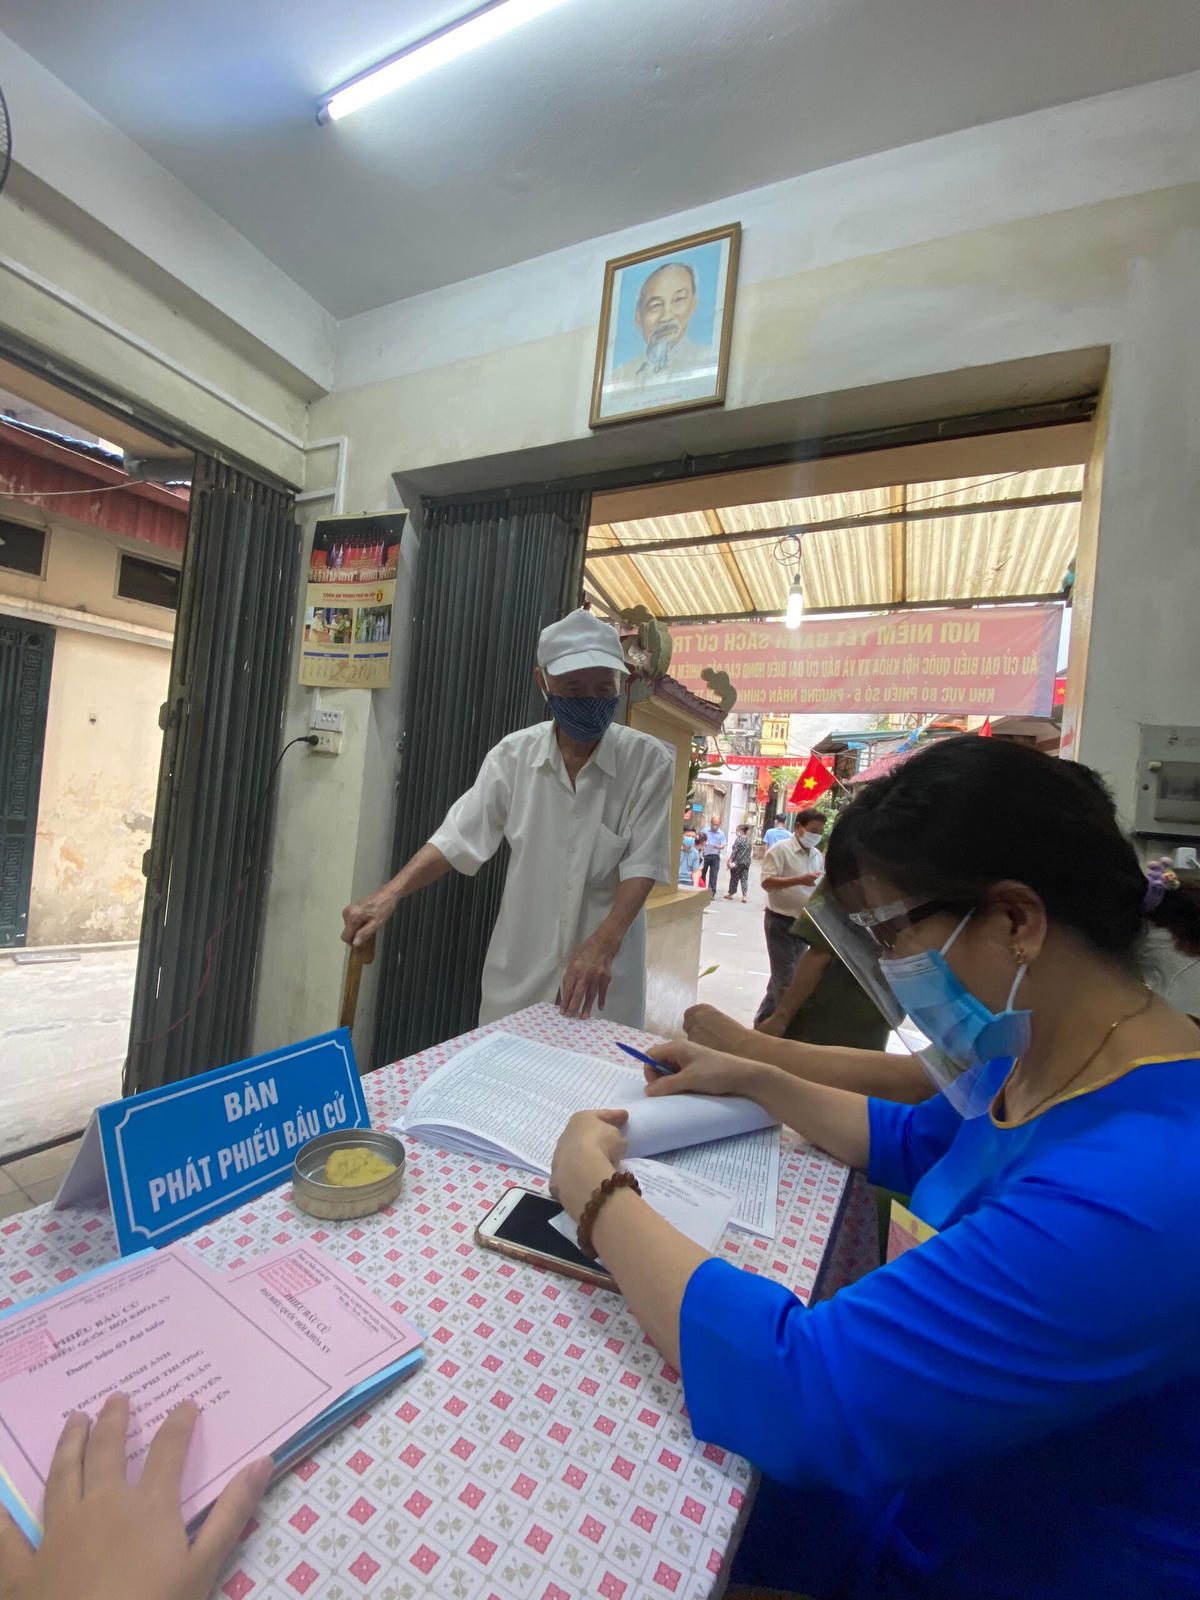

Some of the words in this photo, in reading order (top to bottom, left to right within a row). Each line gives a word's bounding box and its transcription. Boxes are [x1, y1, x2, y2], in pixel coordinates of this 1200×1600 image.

[224, 1078, 279, 1123] BÀN
[149, 1156, 212, 1213] PHÁT
[218, 1122, 280, 1180] PHIẾU
[283, 1105, 320, 1149] BẦU
[323, 1090, 347, 1129] CỬ
